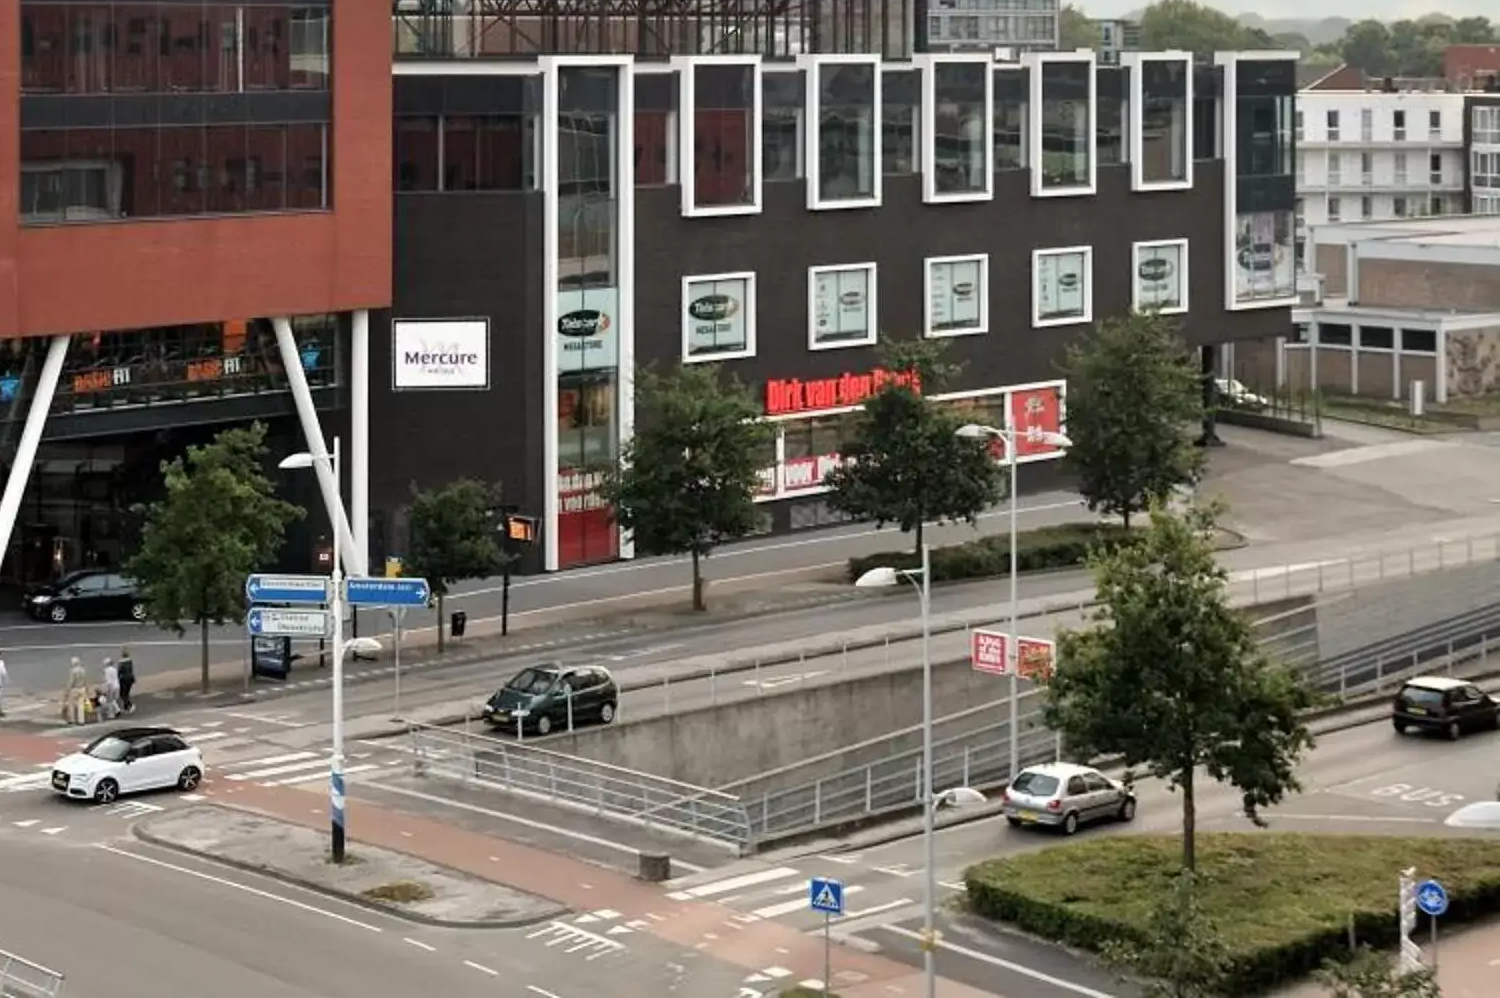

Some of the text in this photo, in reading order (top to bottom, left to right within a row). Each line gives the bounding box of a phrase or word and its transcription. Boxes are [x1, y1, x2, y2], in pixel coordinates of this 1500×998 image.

[404, 351, 478, 366] Mercure
[767, 377, 803, 413] Dirk
[805, 380, 837, 407] van
[1371, 783, 1465, 807] BUS
